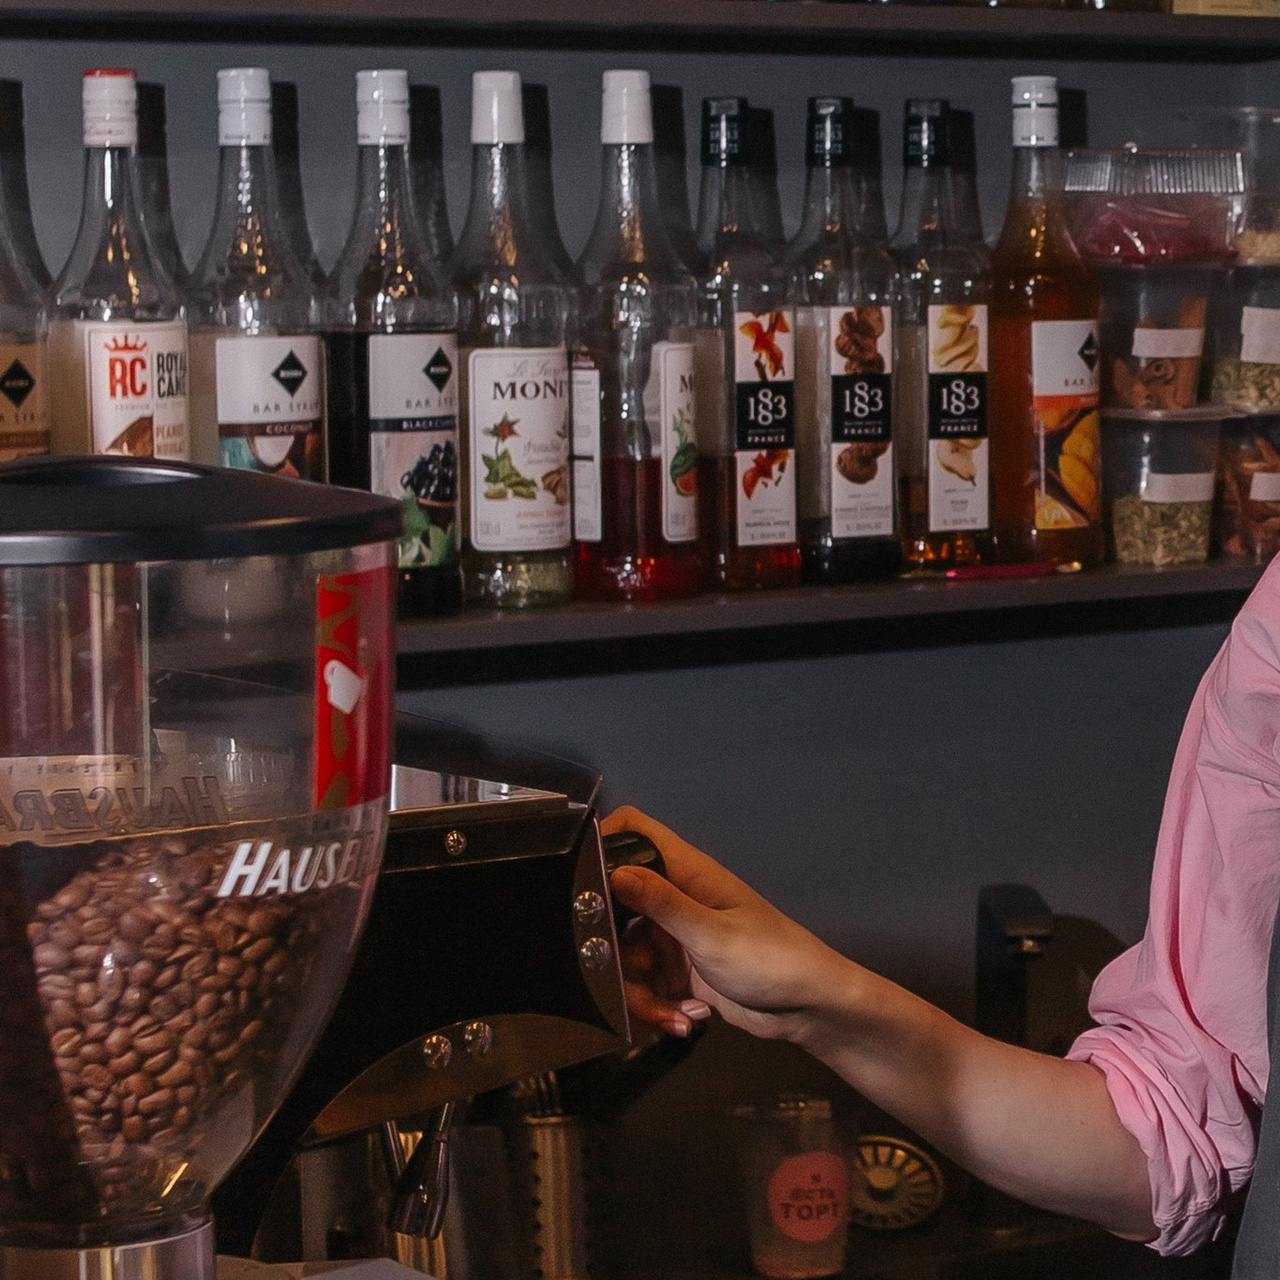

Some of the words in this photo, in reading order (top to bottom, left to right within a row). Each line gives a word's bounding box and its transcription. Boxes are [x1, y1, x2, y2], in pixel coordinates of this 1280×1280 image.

[108, 357, 148, 398] RC
[253, 402, 281, 414] BAR
[780, 1201, 840, 1221] ТОРТ
